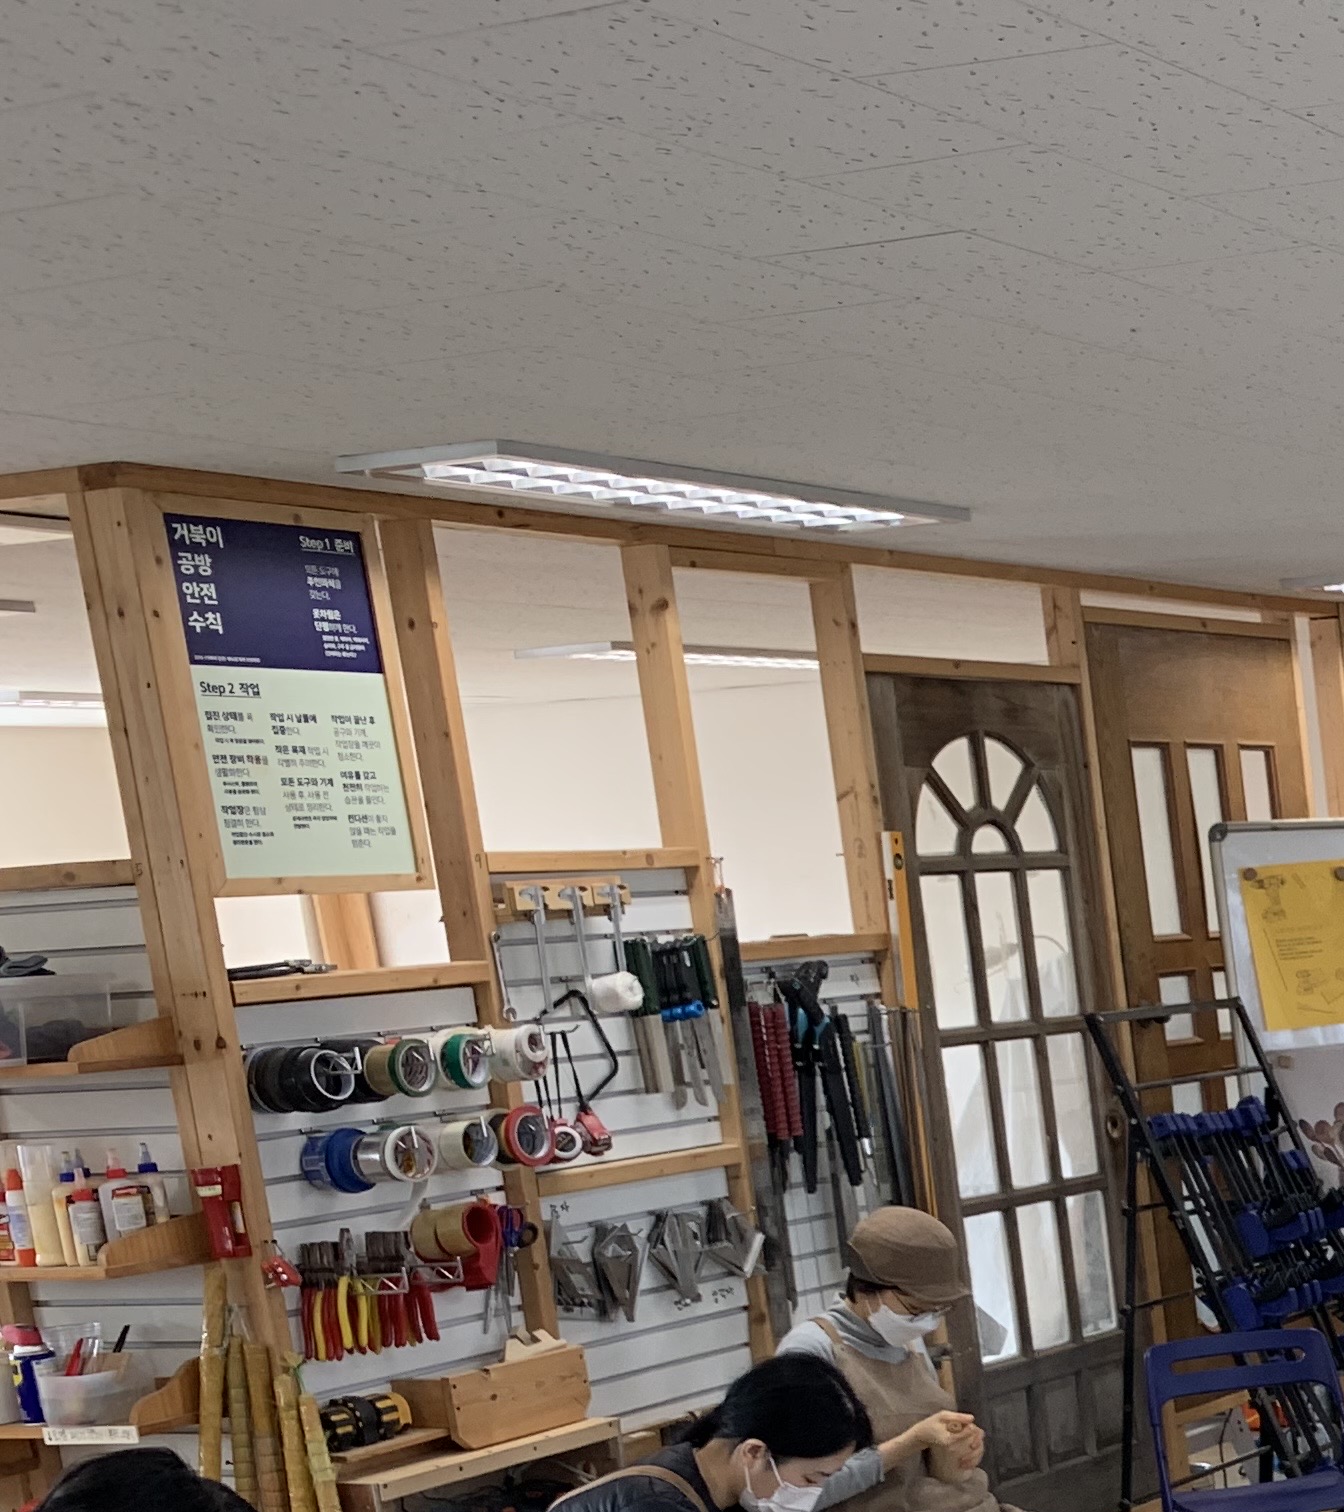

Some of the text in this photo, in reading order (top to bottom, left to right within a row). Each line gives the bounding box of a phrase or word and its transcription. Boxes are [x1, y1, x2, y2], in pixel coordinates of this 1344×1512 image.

[171, 523, 224, 548] 거북이
[299, 536, 324, 551] Step
[325, 538, 331, 550] 1
[177, 552, 213, 576] 공방
[182, 582, 219, 605] 안전
[188, 610, 224, 635] 수칙
[199, 681, 260, 696] Step 2 작업
[286, 714, 294, 722] 시
[297, 777, 318, 787] 도구와
[319, 777, 334, 787] 기계
